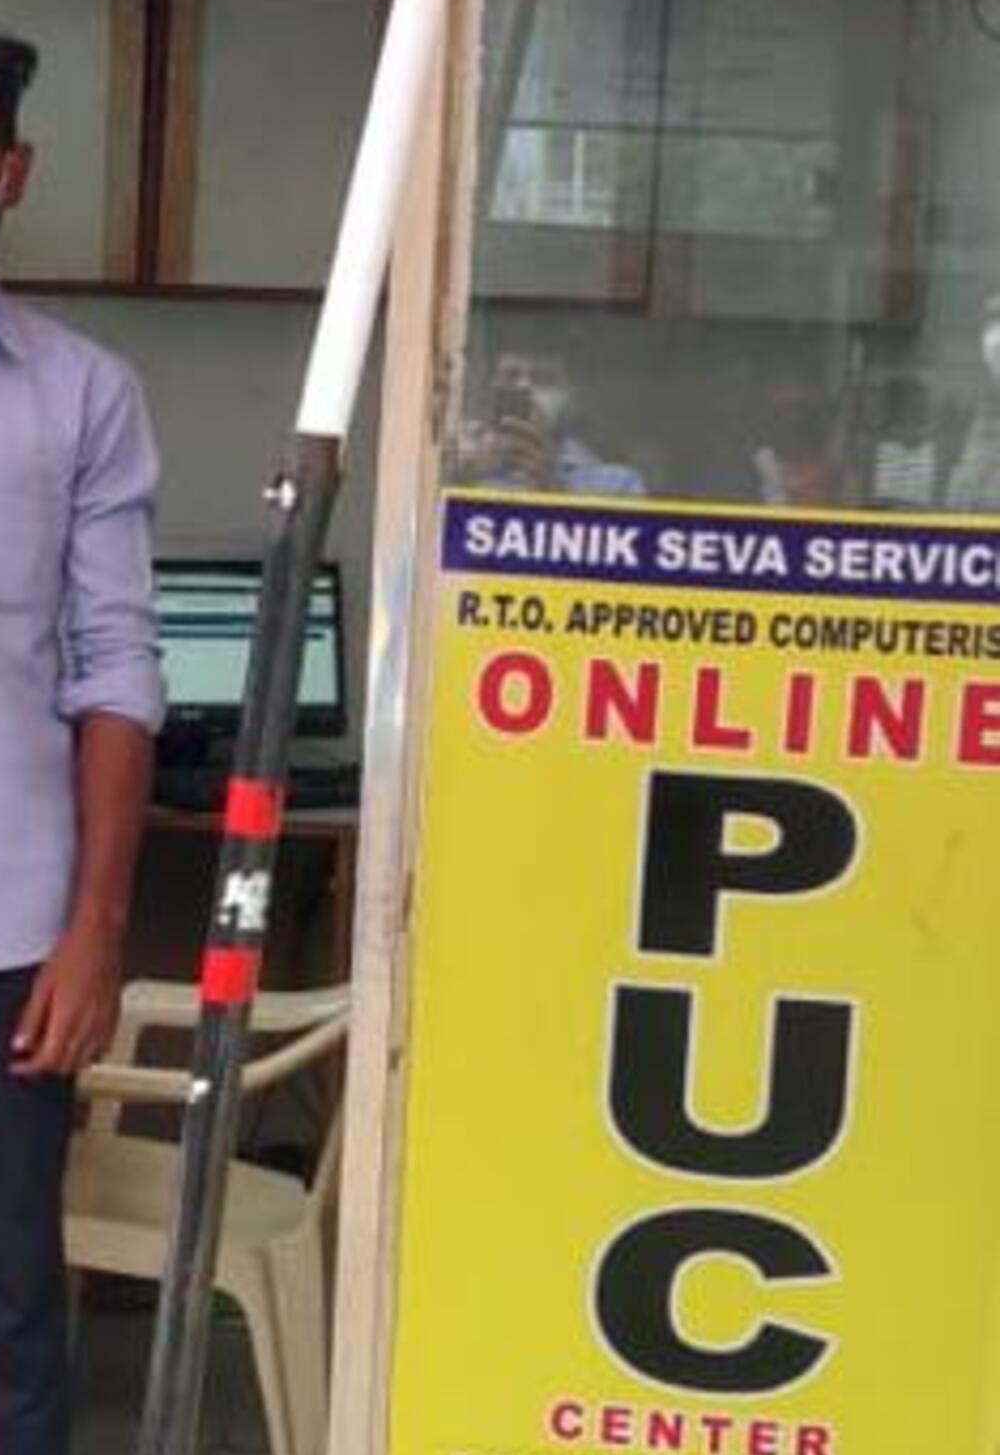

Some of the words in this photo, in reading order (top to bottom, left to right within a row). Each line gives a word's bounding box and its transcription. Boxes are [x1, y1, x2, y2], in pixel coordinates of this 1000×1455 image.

[465, 517, 640, 567] SAINIK
[656, 530, 788, 575] SEVA
[804, 538, 1000, 586] SERVIC
[566, 601, 757, 645] APPROVED
[477, 651, 1000, 765] ONLINE
